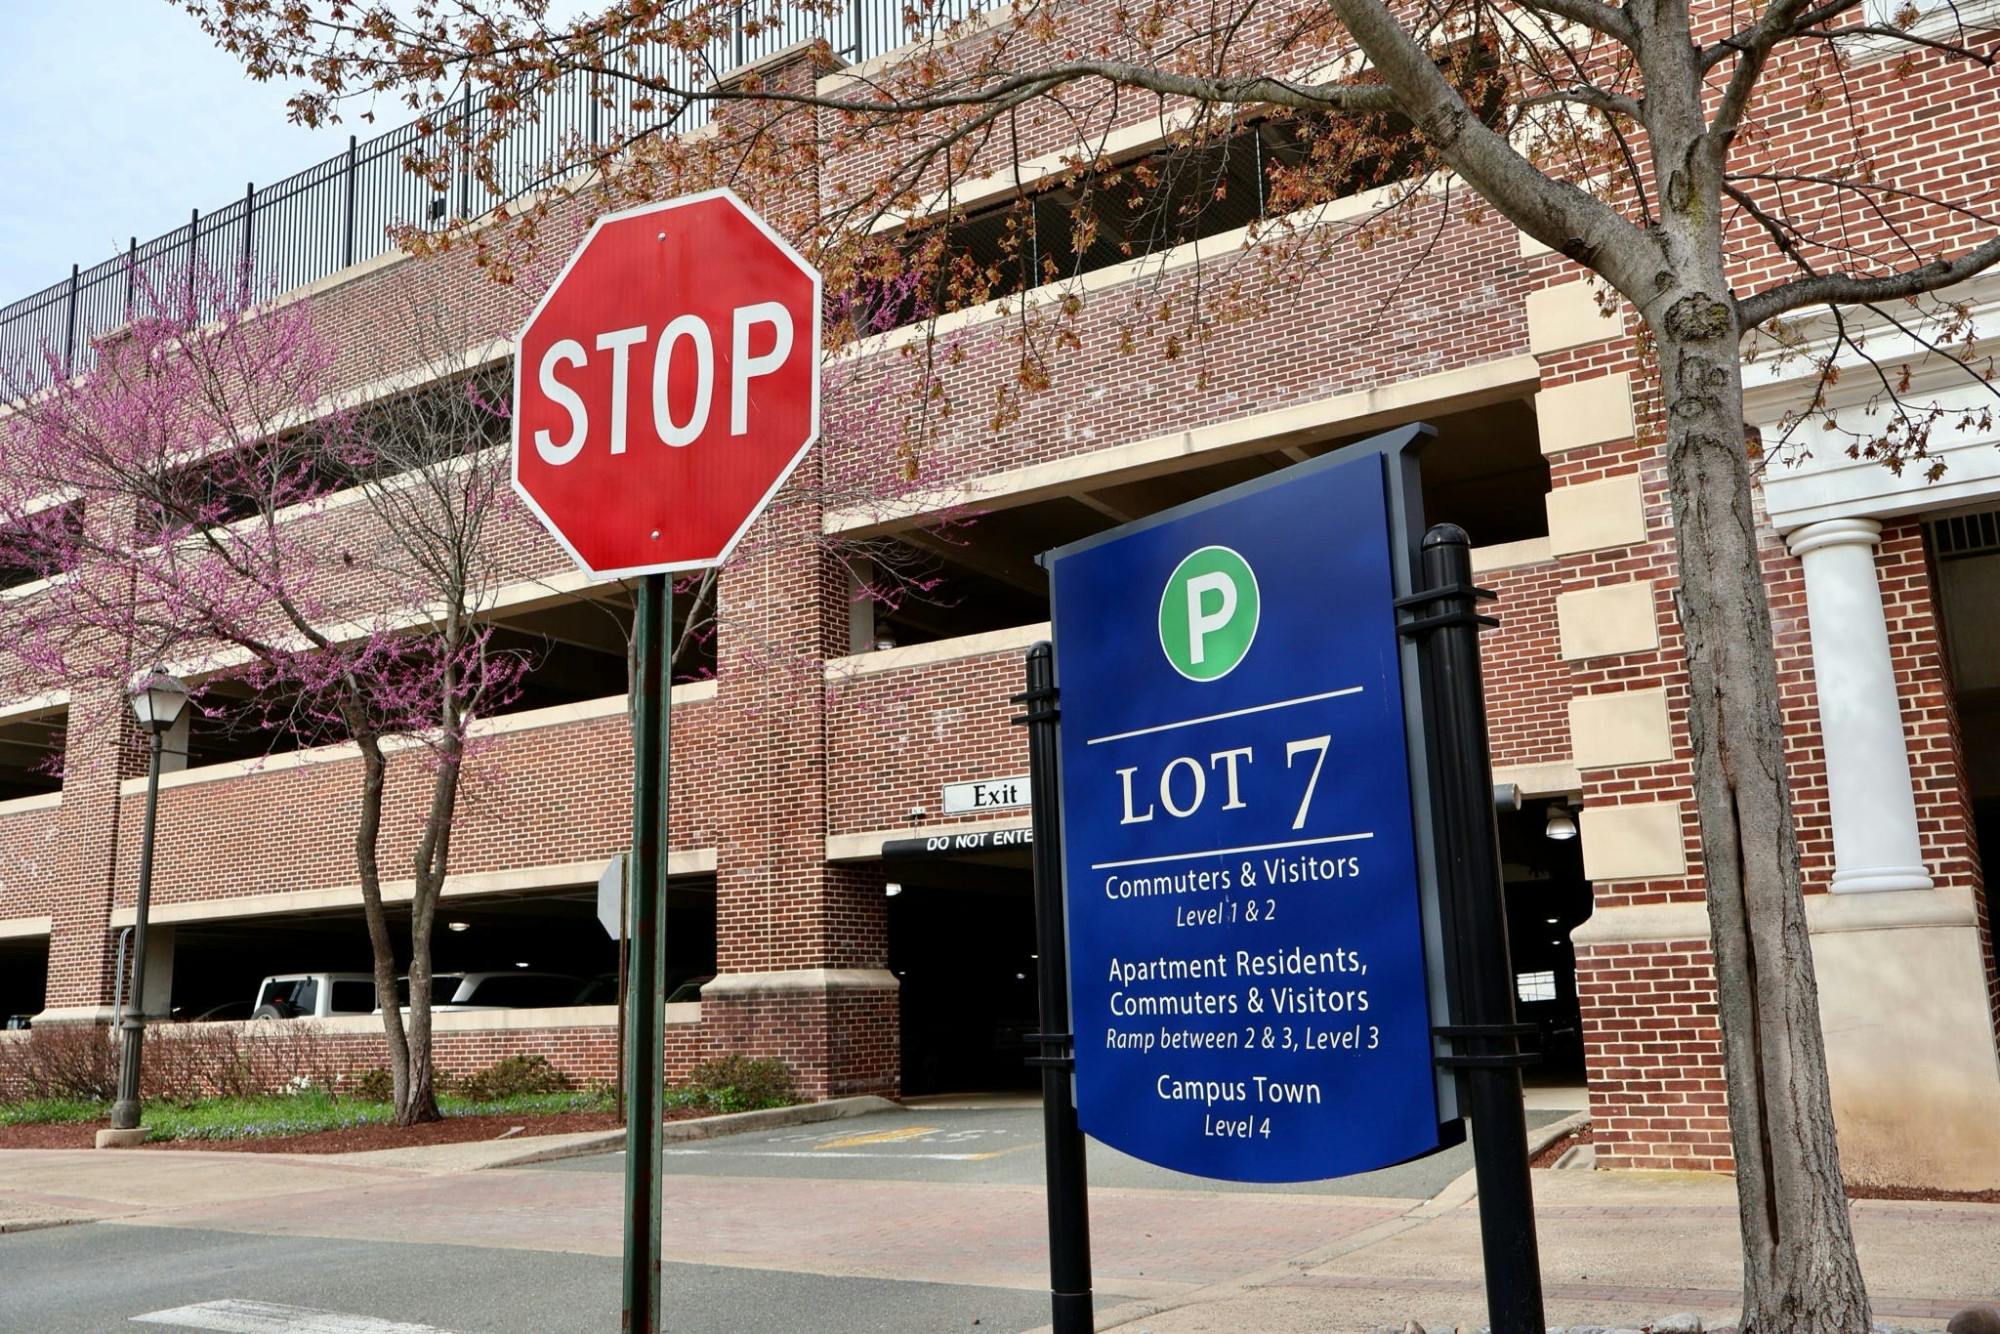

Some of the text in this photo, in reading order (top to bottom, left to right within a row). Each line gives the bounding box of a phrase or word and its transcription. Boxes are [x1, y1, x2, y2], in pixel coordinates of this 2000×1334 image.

[533, 301, 794, 466] STOP
[1186, 571, 1238, 664] P
[974, 784, 1017, 807] Exit
[1115, 734, 1332, 830] LOT 7
[927, 836, 950, 851] DO
[955, 832, 988, 849] NOT
[1105, 856, 1360, 900] Commuters & Visitors
[1176, 899, 1276, 927] Level 1 & 2
[1109, 946, 1368, 988] Apartment Residents,
[1110, 986, 1369, 1016] Commuters & Visitors
[1106, 1025, 1379, 1054] Ramp between 2 & 3, Level 3
[1157, 1074, 1321, 1107] Campus Town
[1205, 1114, 1271, 1139] Level 4
